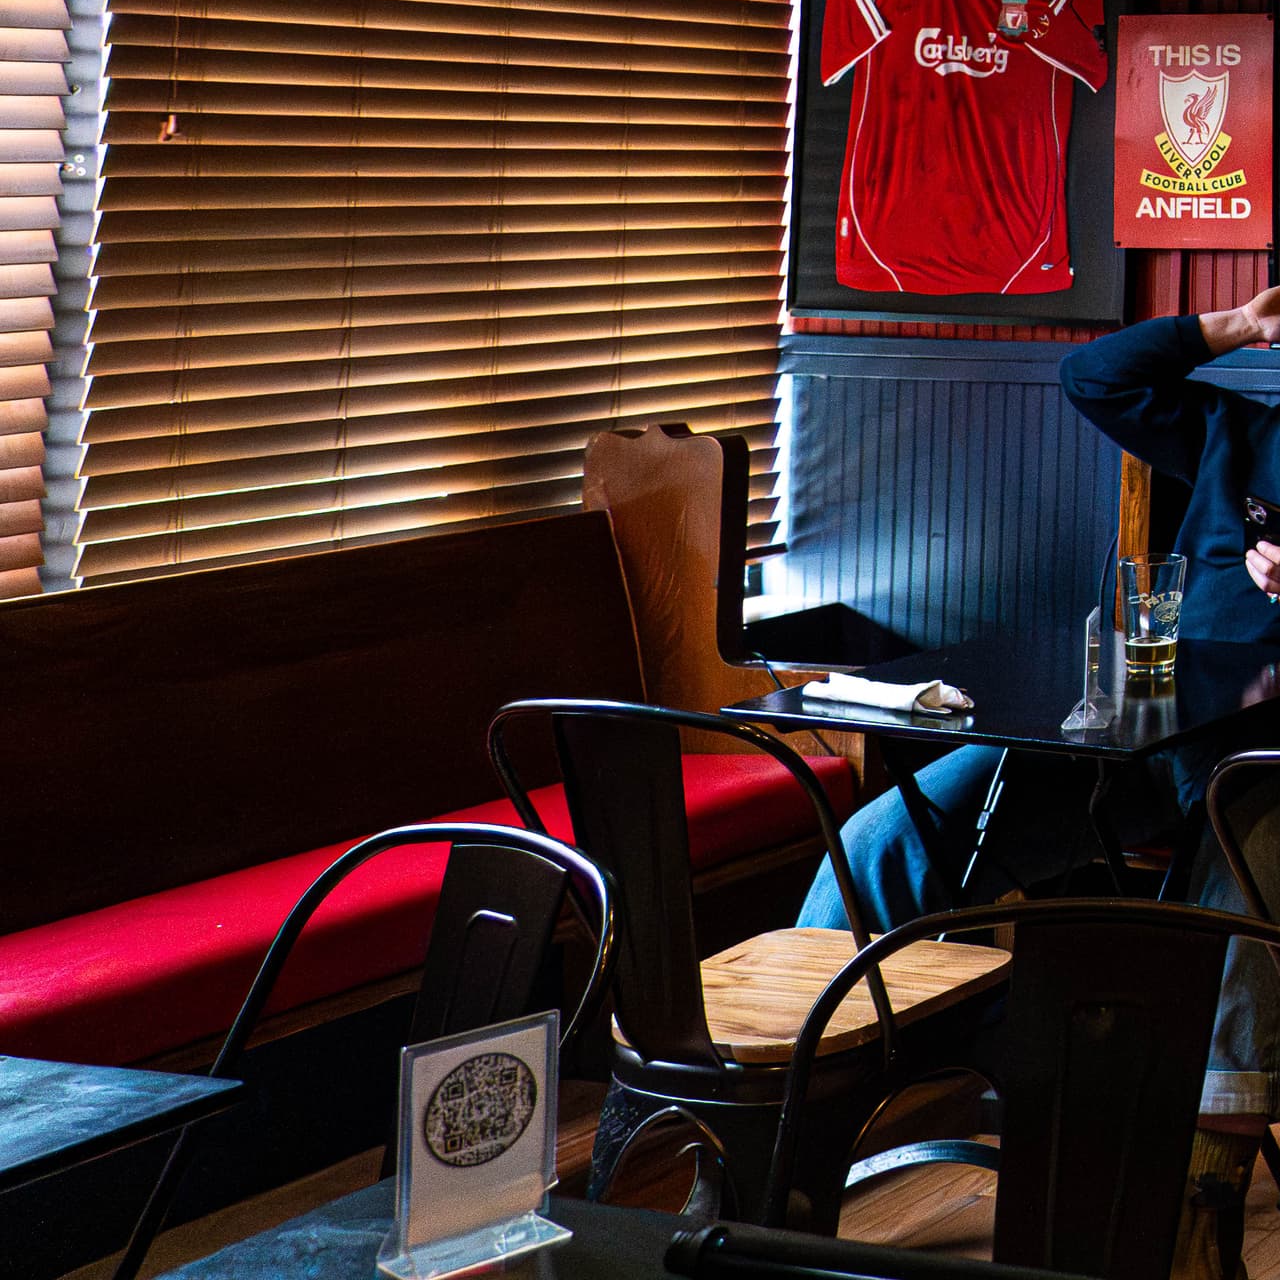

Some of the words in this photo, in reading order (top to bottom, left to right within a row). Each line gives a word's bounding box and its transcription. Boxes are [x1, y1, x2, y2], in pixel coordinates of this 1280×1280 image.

[914, 27, 1010, 77] Carlsberg
[1148, 44, 1211, 67] THIS
[1215, 44, 1242, 66] IS
[1159, 140, 1226, 179] LIVERPOOL
[1144, 173, 1209, 192] FOOTBALL
[1211, 174, 1243, 190] CLUB
[1135, 197, 1252, 219] ANFIELD
